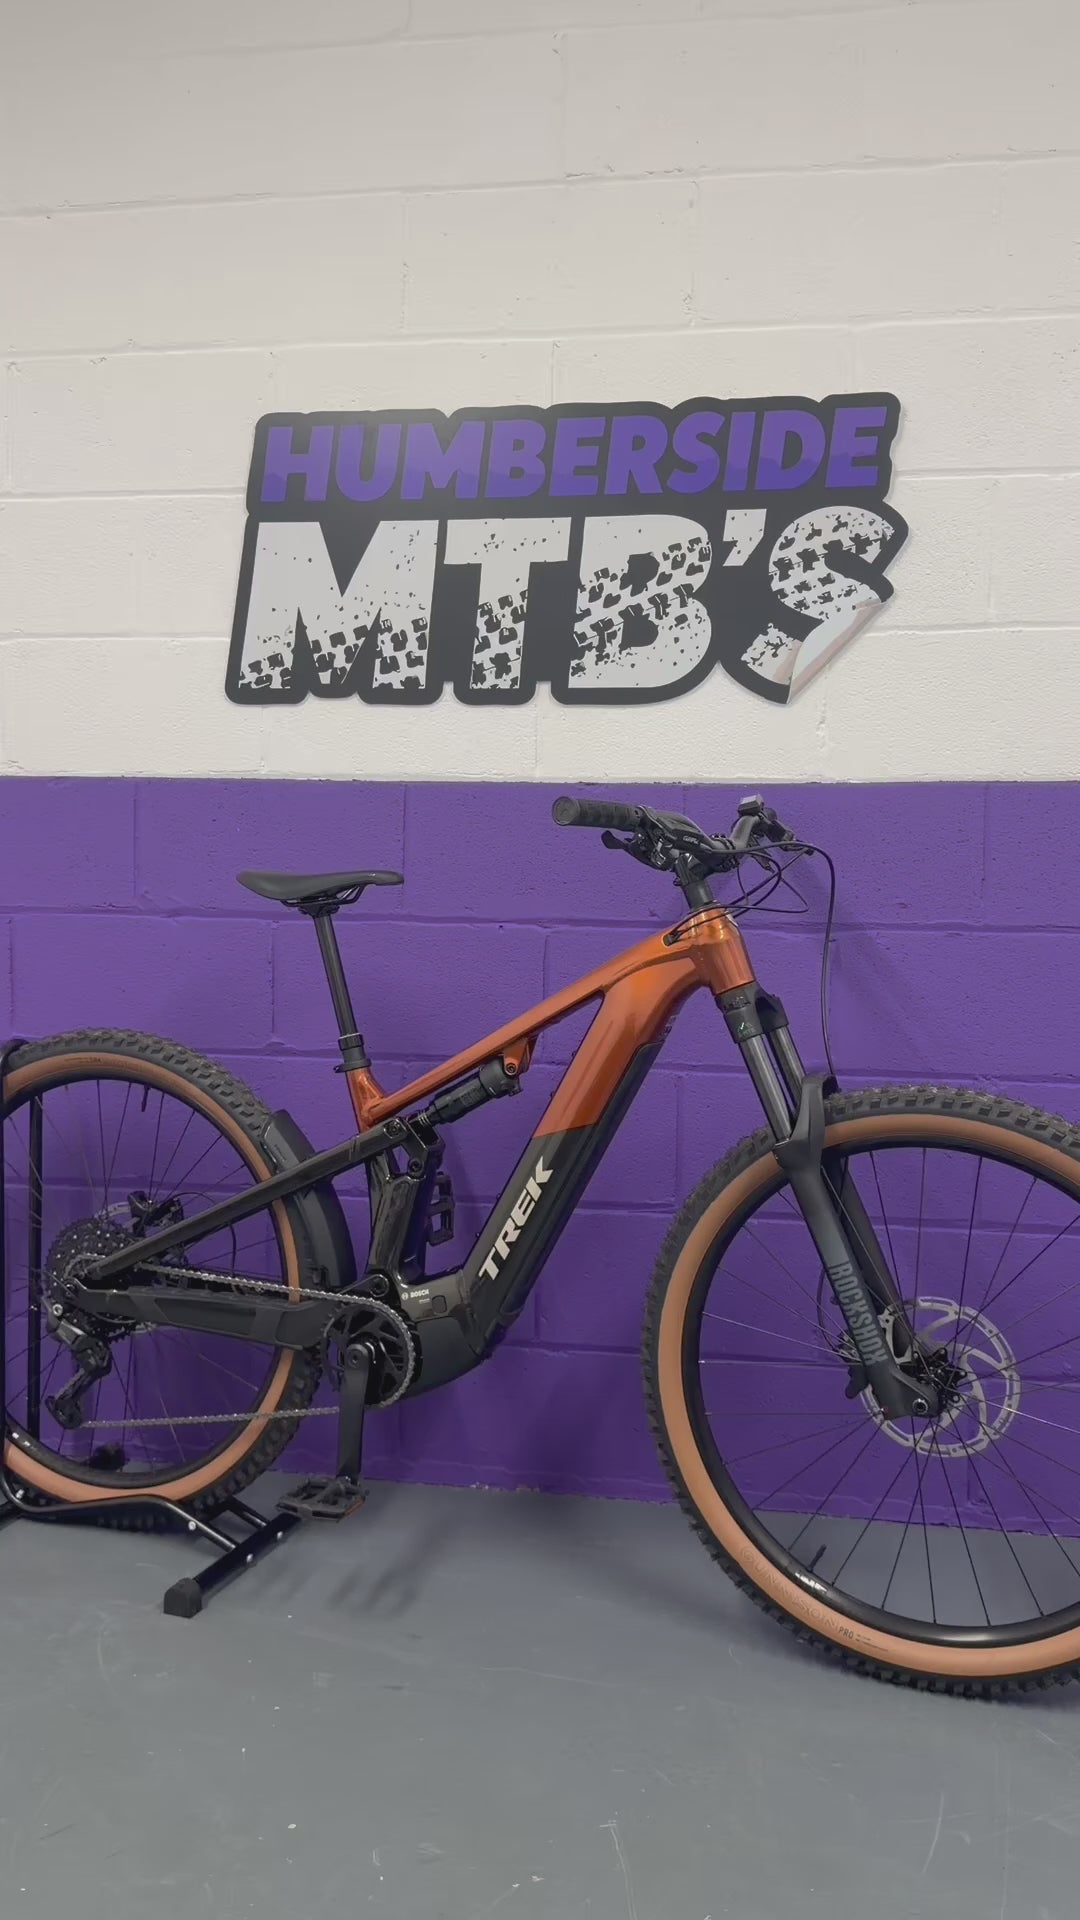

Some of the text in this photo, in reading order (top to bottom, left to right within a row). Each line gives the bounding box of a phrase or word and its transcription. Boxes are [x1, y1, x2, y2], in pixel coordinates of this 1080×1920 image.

[260, 406, 888, 501] HUMBERSIDE
[478, 1156, 554, 1280] TREK
[828, 1262, 888, 1366] ROCKSHOX
[838, 1626, 855, 1640] PRO
